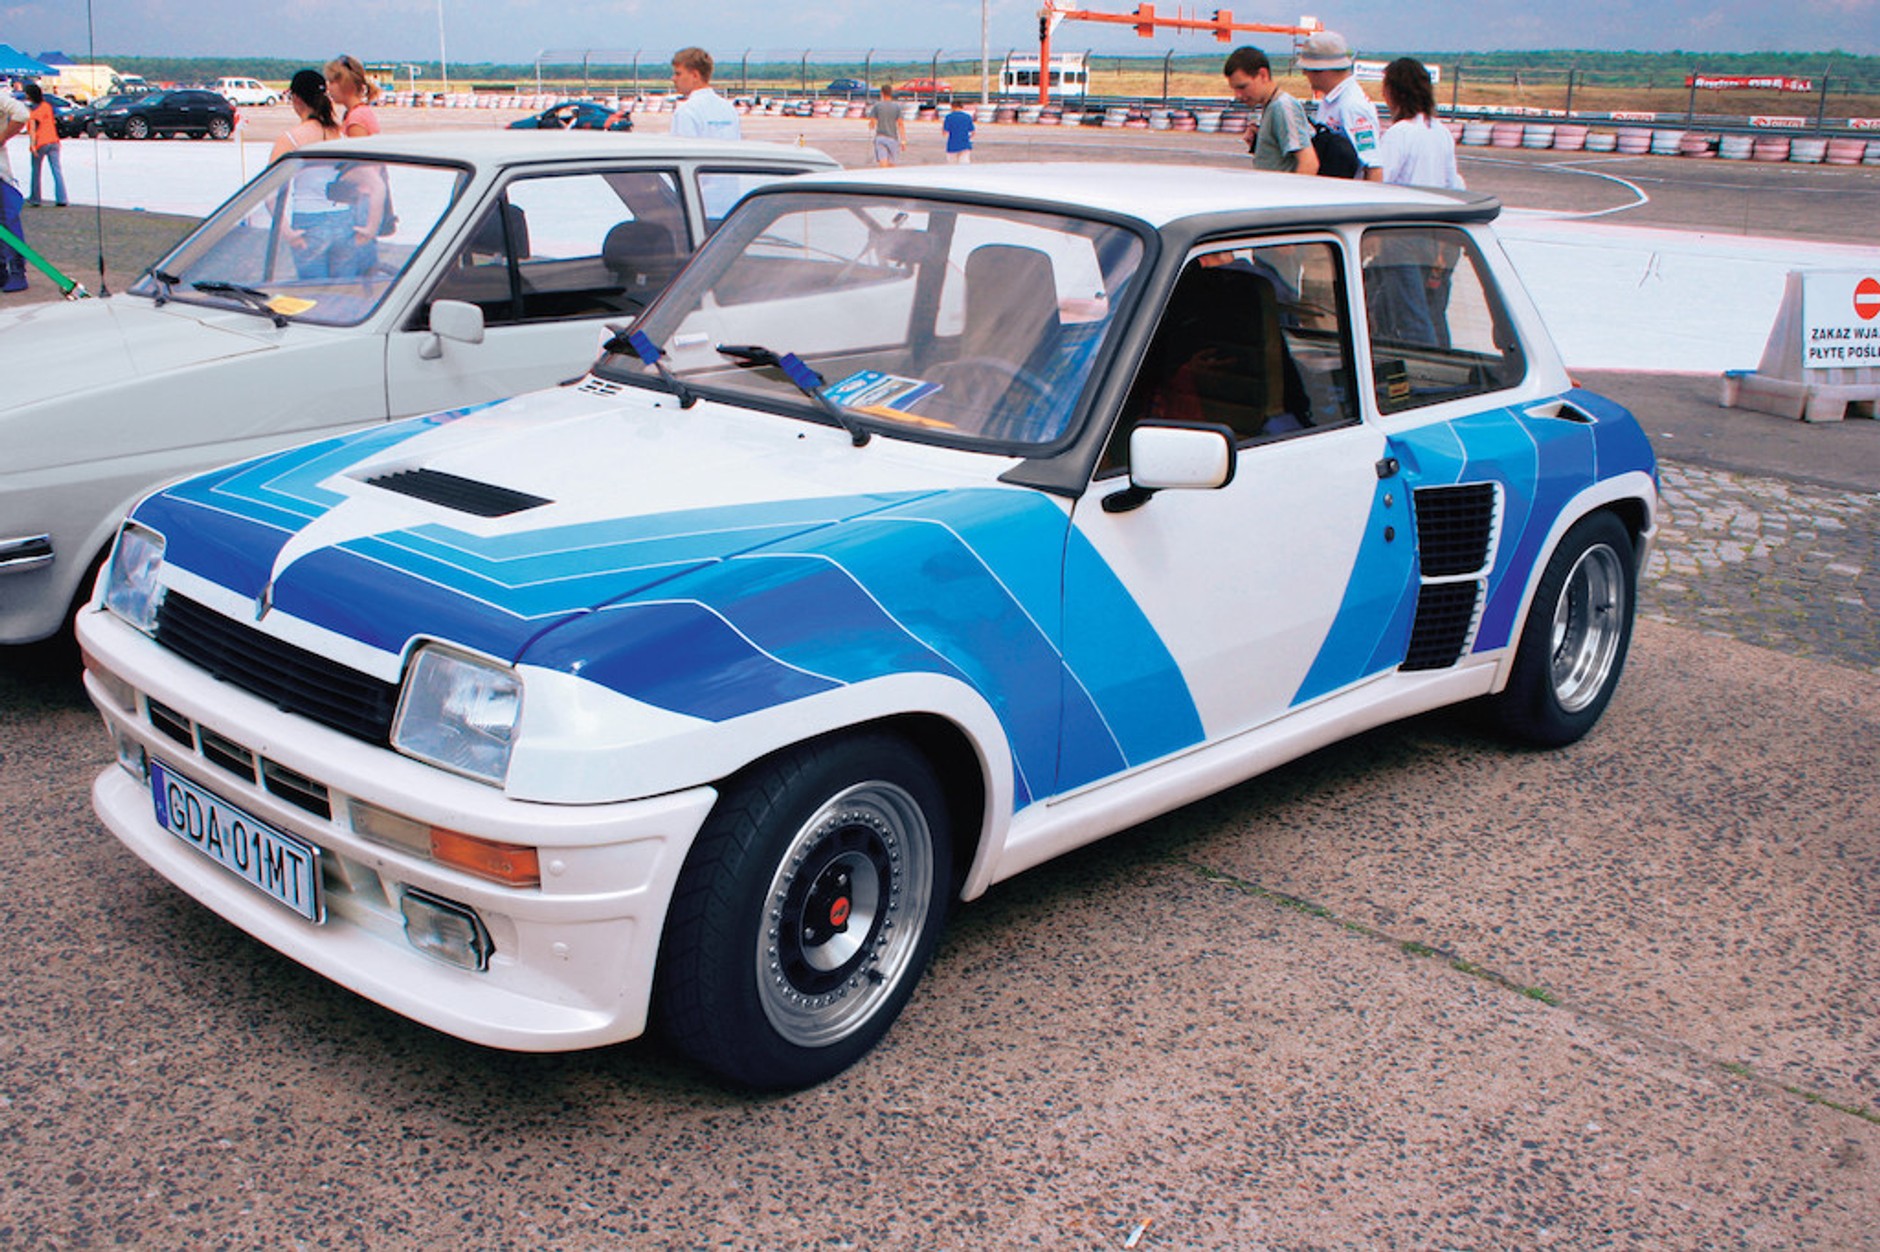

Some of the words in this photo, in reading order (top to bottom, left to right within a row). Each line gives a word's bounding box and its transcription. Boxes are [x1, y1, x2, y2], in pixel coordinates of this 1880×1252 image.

[1811, 328, 1851, 340] ZAKAZ
[1854, 327, 1880, 339] WJA
[1809, 346, 1845, 361] PŁYTĘ
[168, 781, 224, 858] GDA
[233, 820, 305, 904] 01MT
